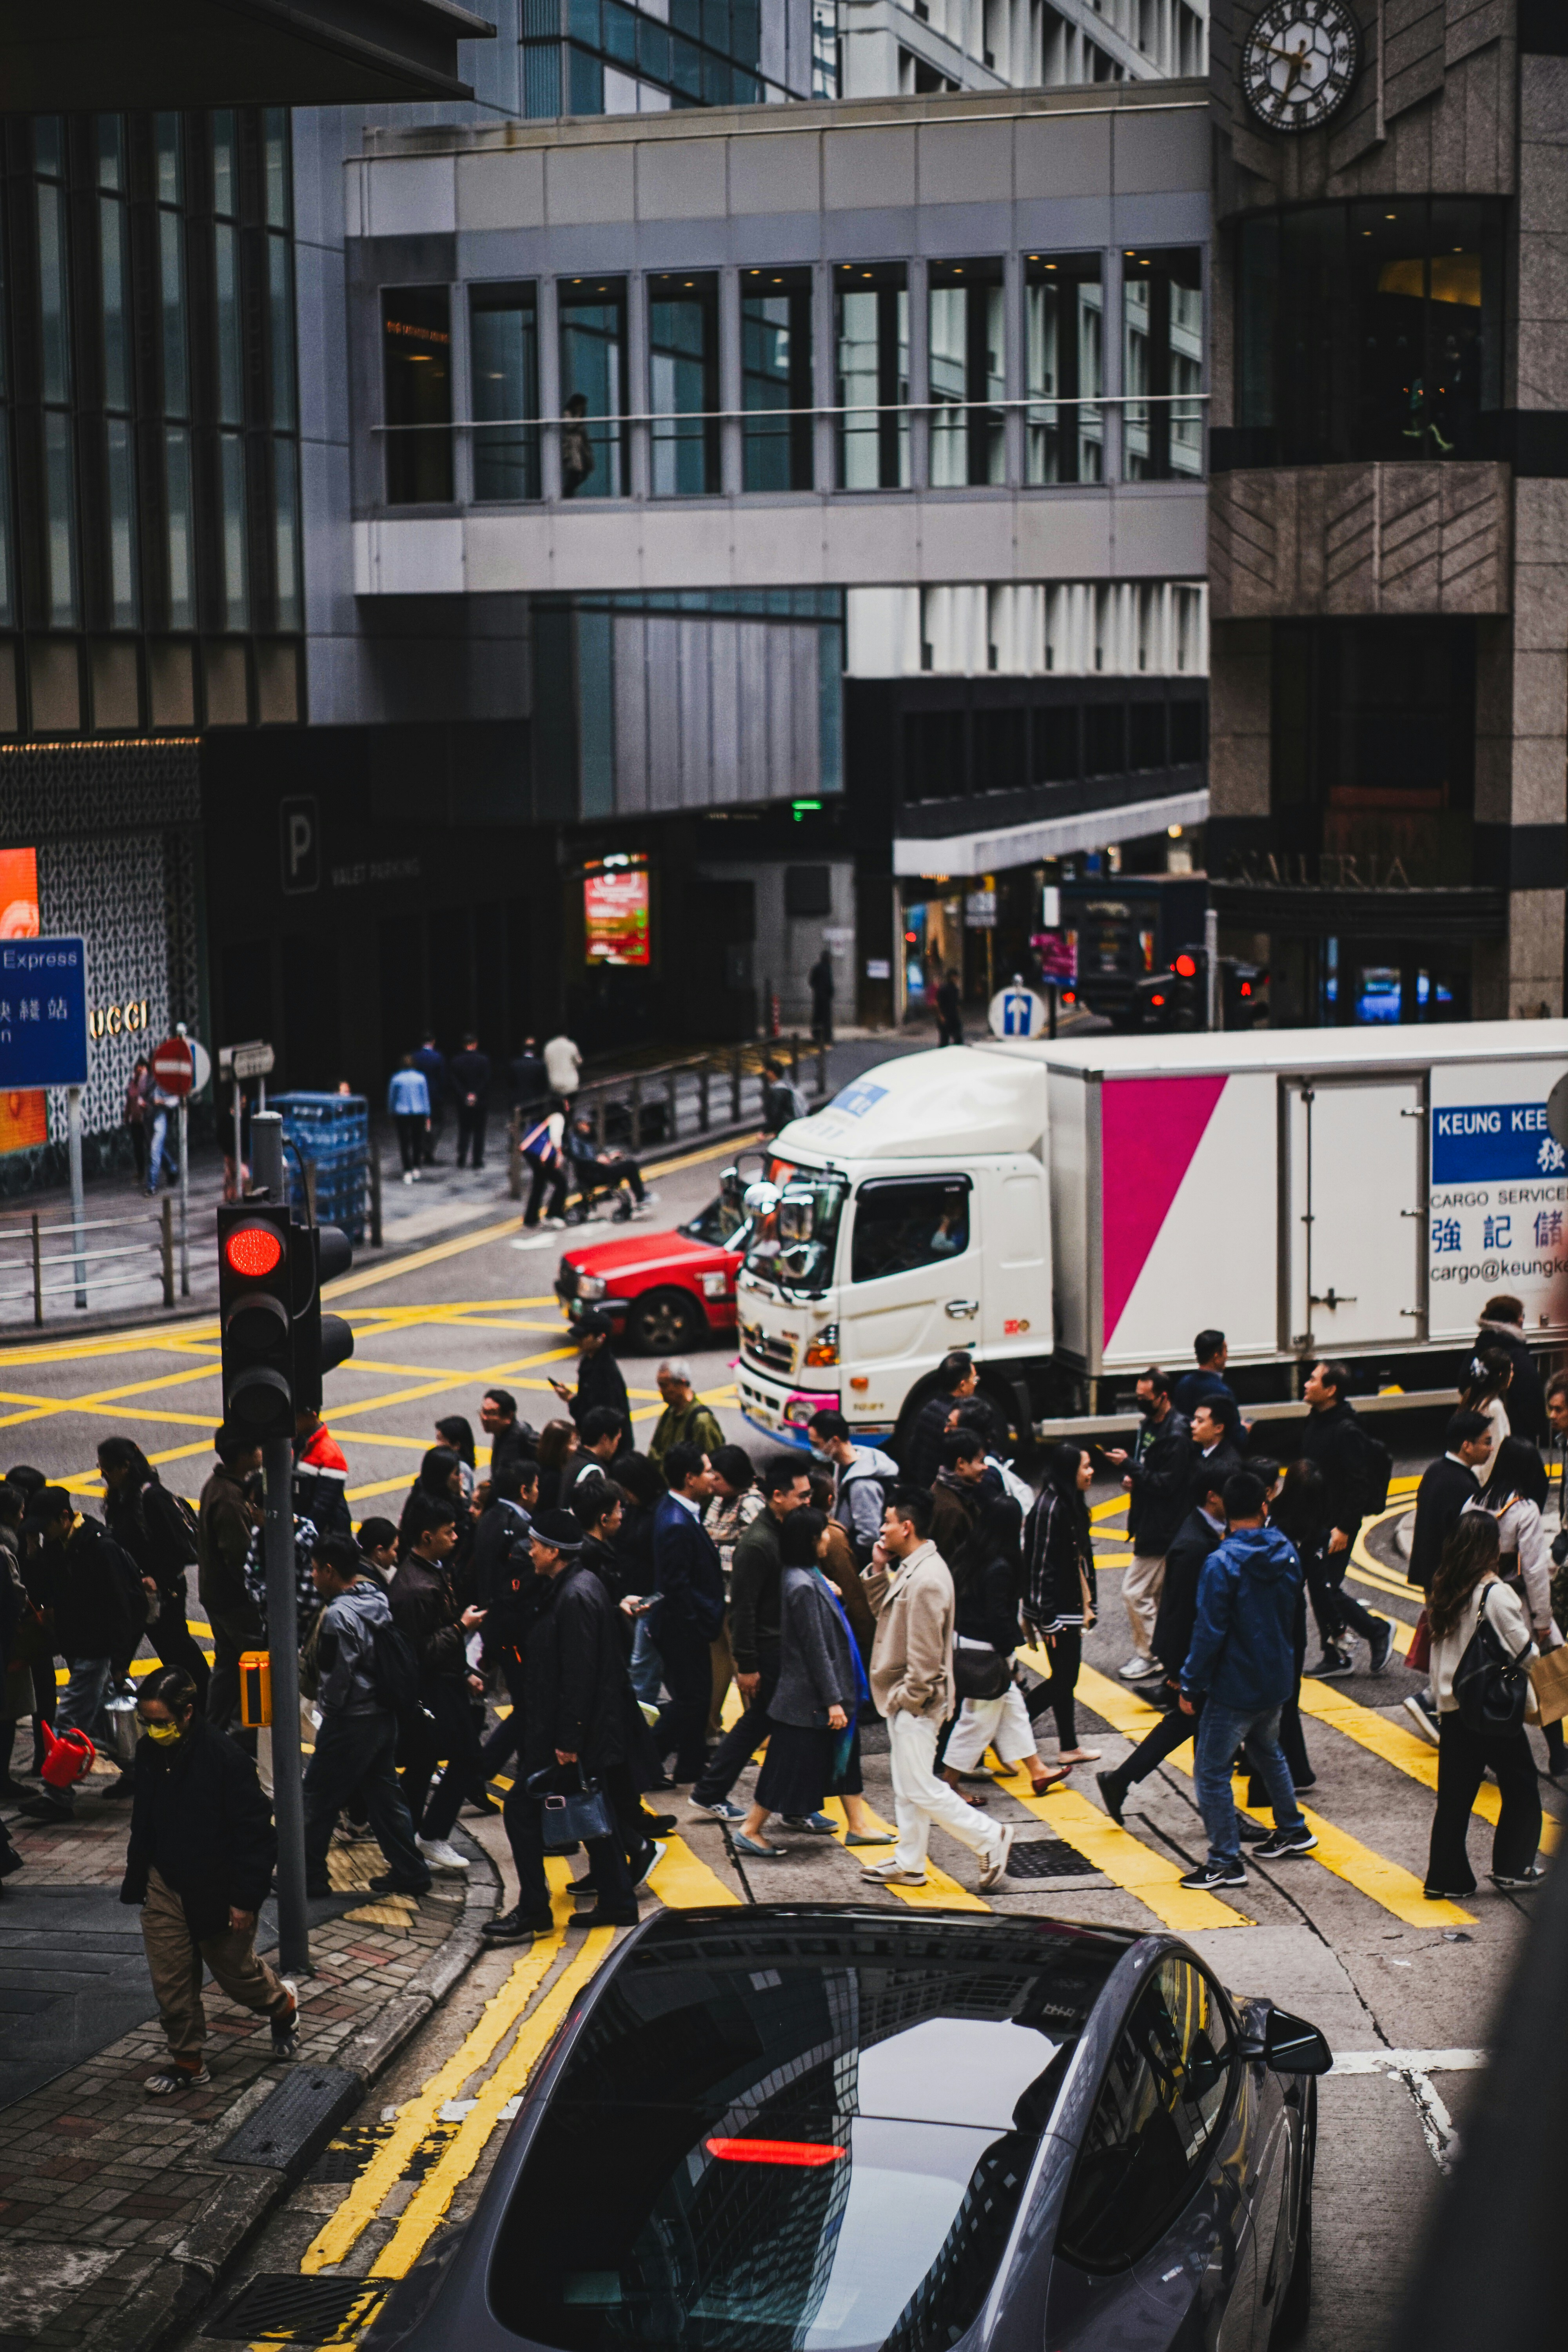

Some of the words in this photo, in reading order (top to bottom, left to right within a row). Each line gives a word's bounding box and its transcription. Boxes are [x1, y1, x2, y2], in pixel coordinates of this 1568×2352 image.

[290, 814, 311, 877] P
[3, 949, 77, 971] Express
[1438, 1111, 1501, 1136] KEUNG
[1512, 1109, 1548, 1132] KEE
[1431, 1191, 1489, 1209] CARGO
[1498, 1185, 1568, 1206] SERVICE
